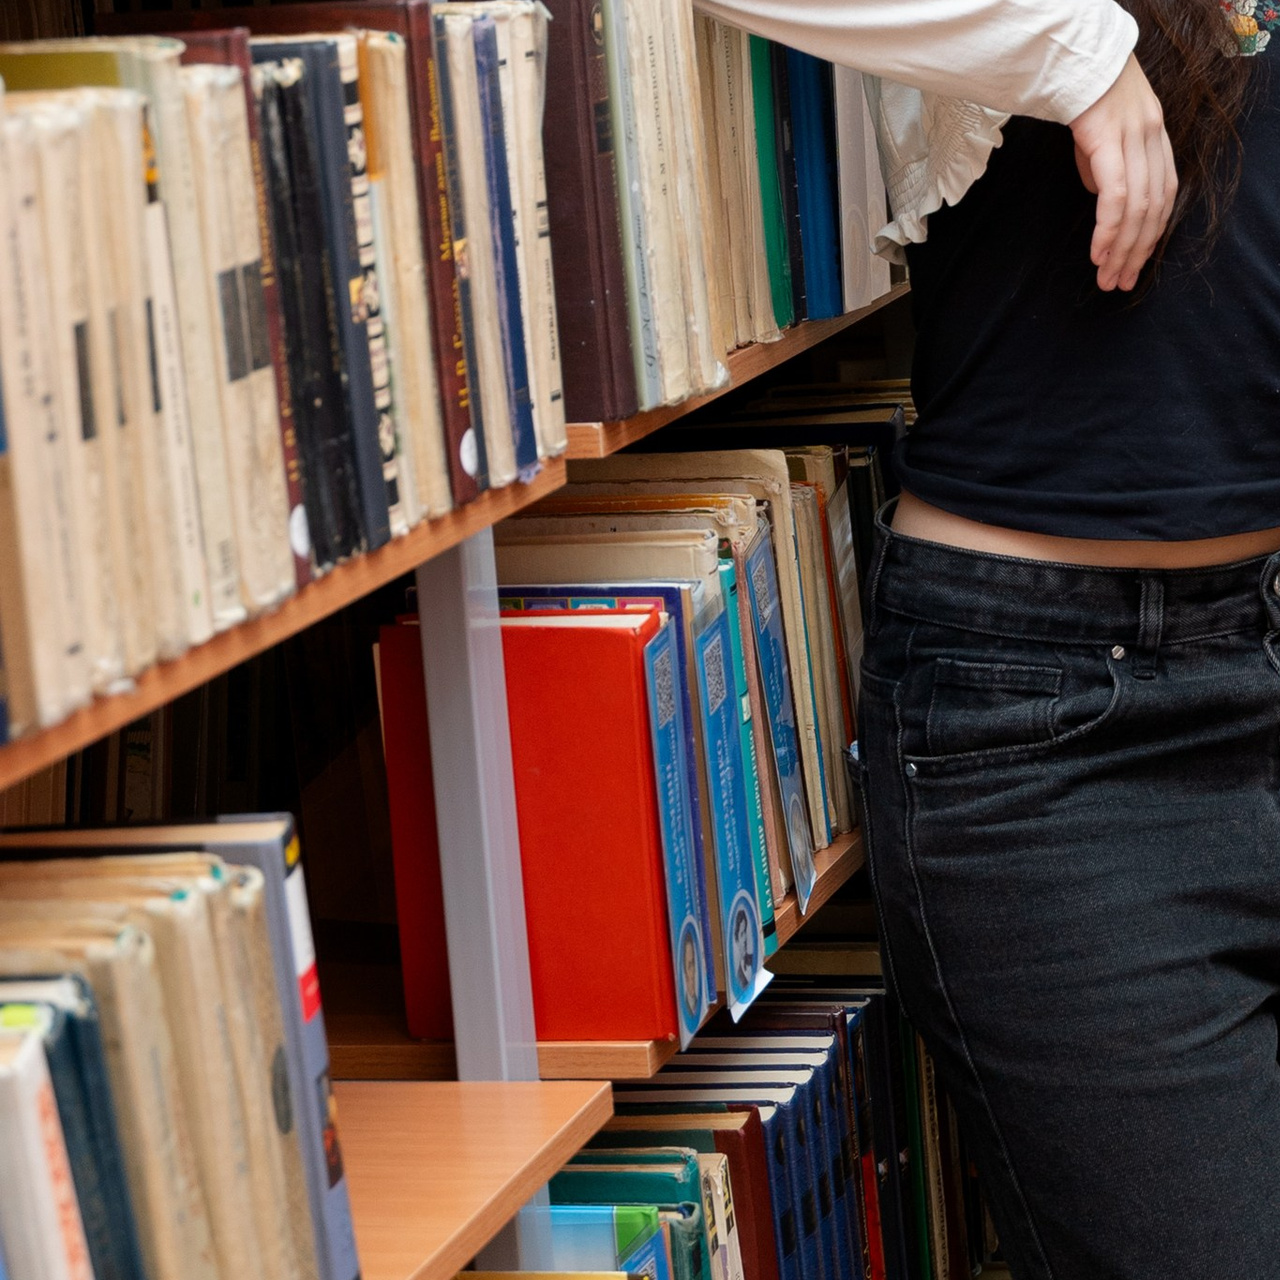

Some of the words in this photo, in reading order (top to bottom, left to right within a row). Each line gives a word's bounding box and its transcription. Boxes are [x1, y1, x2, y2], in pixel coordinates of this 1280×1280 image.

[647, 34, 665, 155] ДОСТОЕВСКИЙ
[747, 728, 764, 820] КОРОЛЕНКО
[754, 824, 773, 911] ВЛАДИМИР
